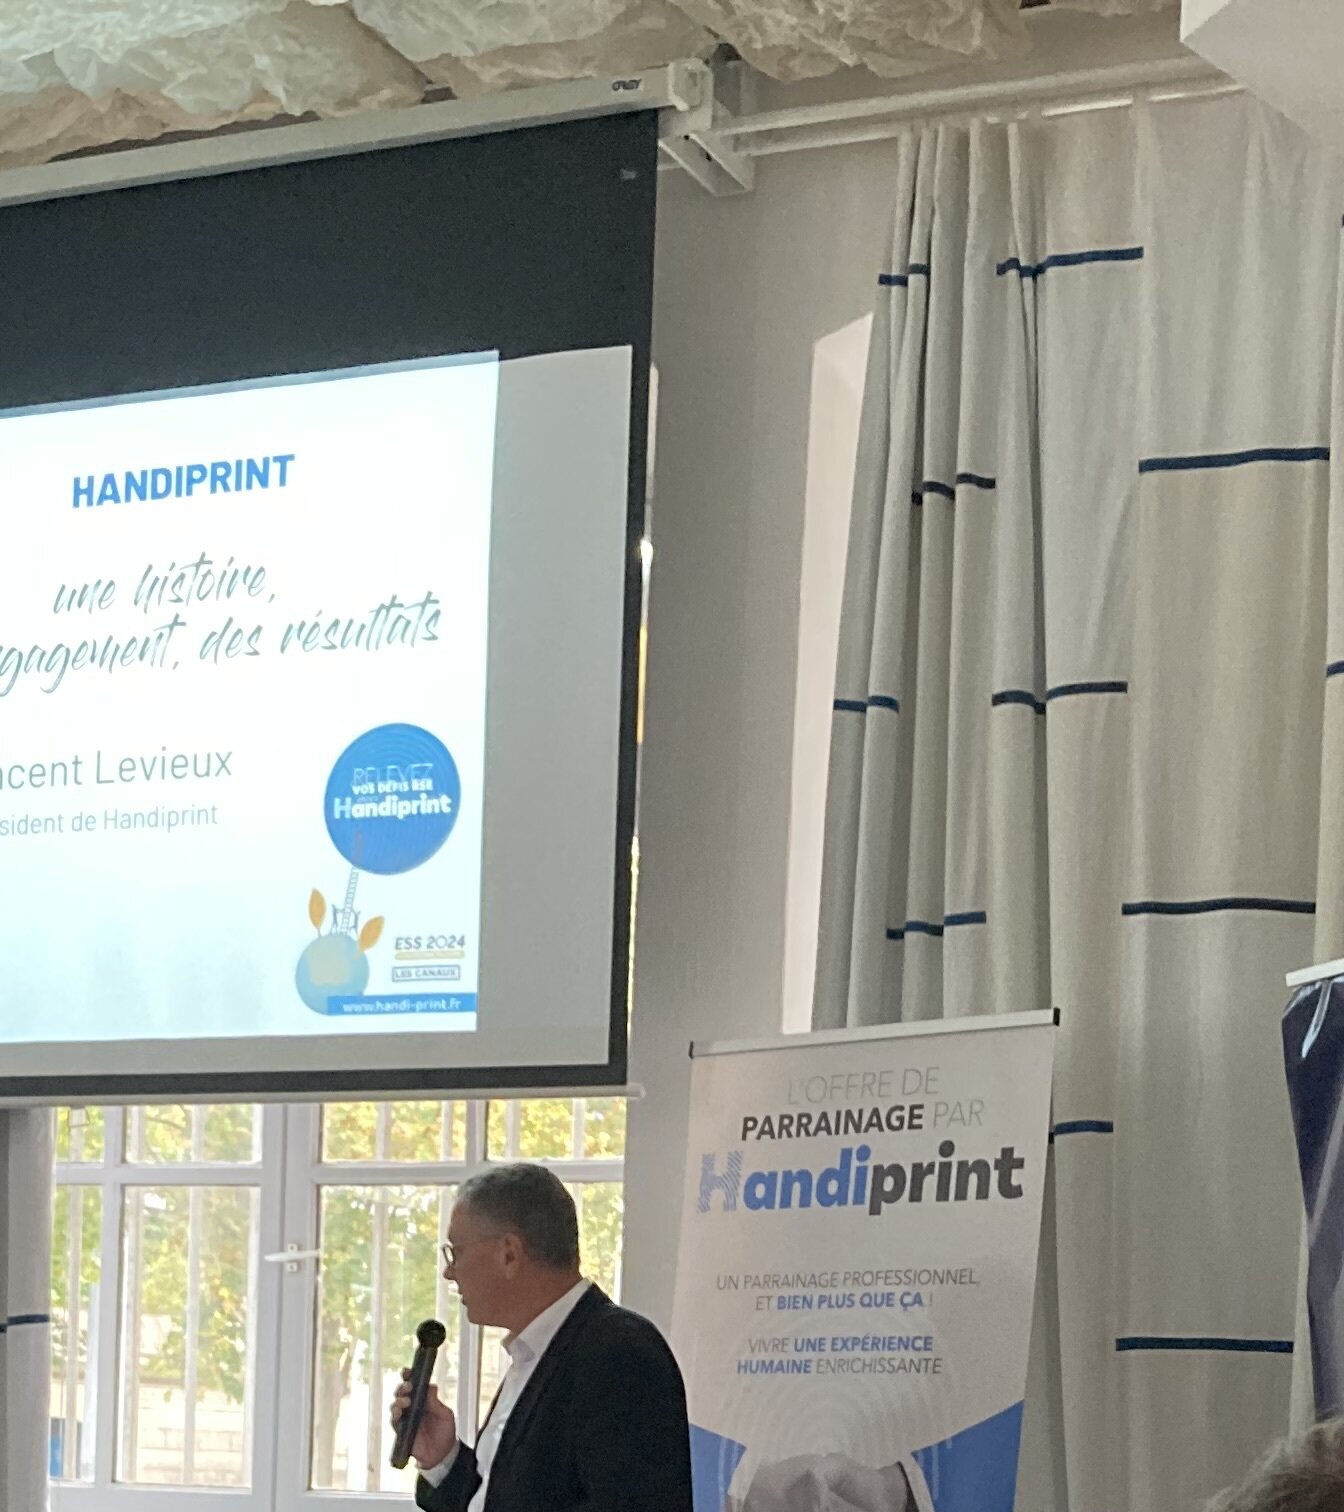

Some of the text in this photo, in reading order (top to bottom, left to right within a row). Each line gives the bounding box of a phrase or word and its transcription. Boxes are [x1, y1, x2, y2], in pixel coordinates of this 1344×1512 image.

[72, 453, 296, 508] HANDIPRINT
[52, 551, 276, 614] une histoire,
[199, 616, 261, 665] des
[280, 590, 442, 654] résultats
[96, 746, 233, 784] Levieux
[71, 811, 97, 832] de
[103, 804, 218, 833] Handiprint
[334, 792, 452, 820] Handiprint
[395, 935, 465, 950] ESS 2024
[343, 998, 462, 1012] www.handi-print.fr
[787, 1066, 940, 1105] L'OFFRE DE
[741, 1098, 985, 1141] PARRAINAGE PAR
[697, 1139, 1025, 1216] Handiprint
[717, 1275, 739, 1289] UN
[743, 1273, 839, 1289] PARRAINAGE
[755, 1296, 773, 1310] ET
[777, 1295, 813, 1310] BIEN
[817, 1294, 855, 1309] PLUS
[859, 1293, 895, 1308] QUE
[899, 1292, 924, 1311] ÇA
[748, 1333, 934, 1353] VIVRE UNE EXPÉRIENCE
[737, 1358, 943, 1374] HUMAINE ENRICHISSANTE
